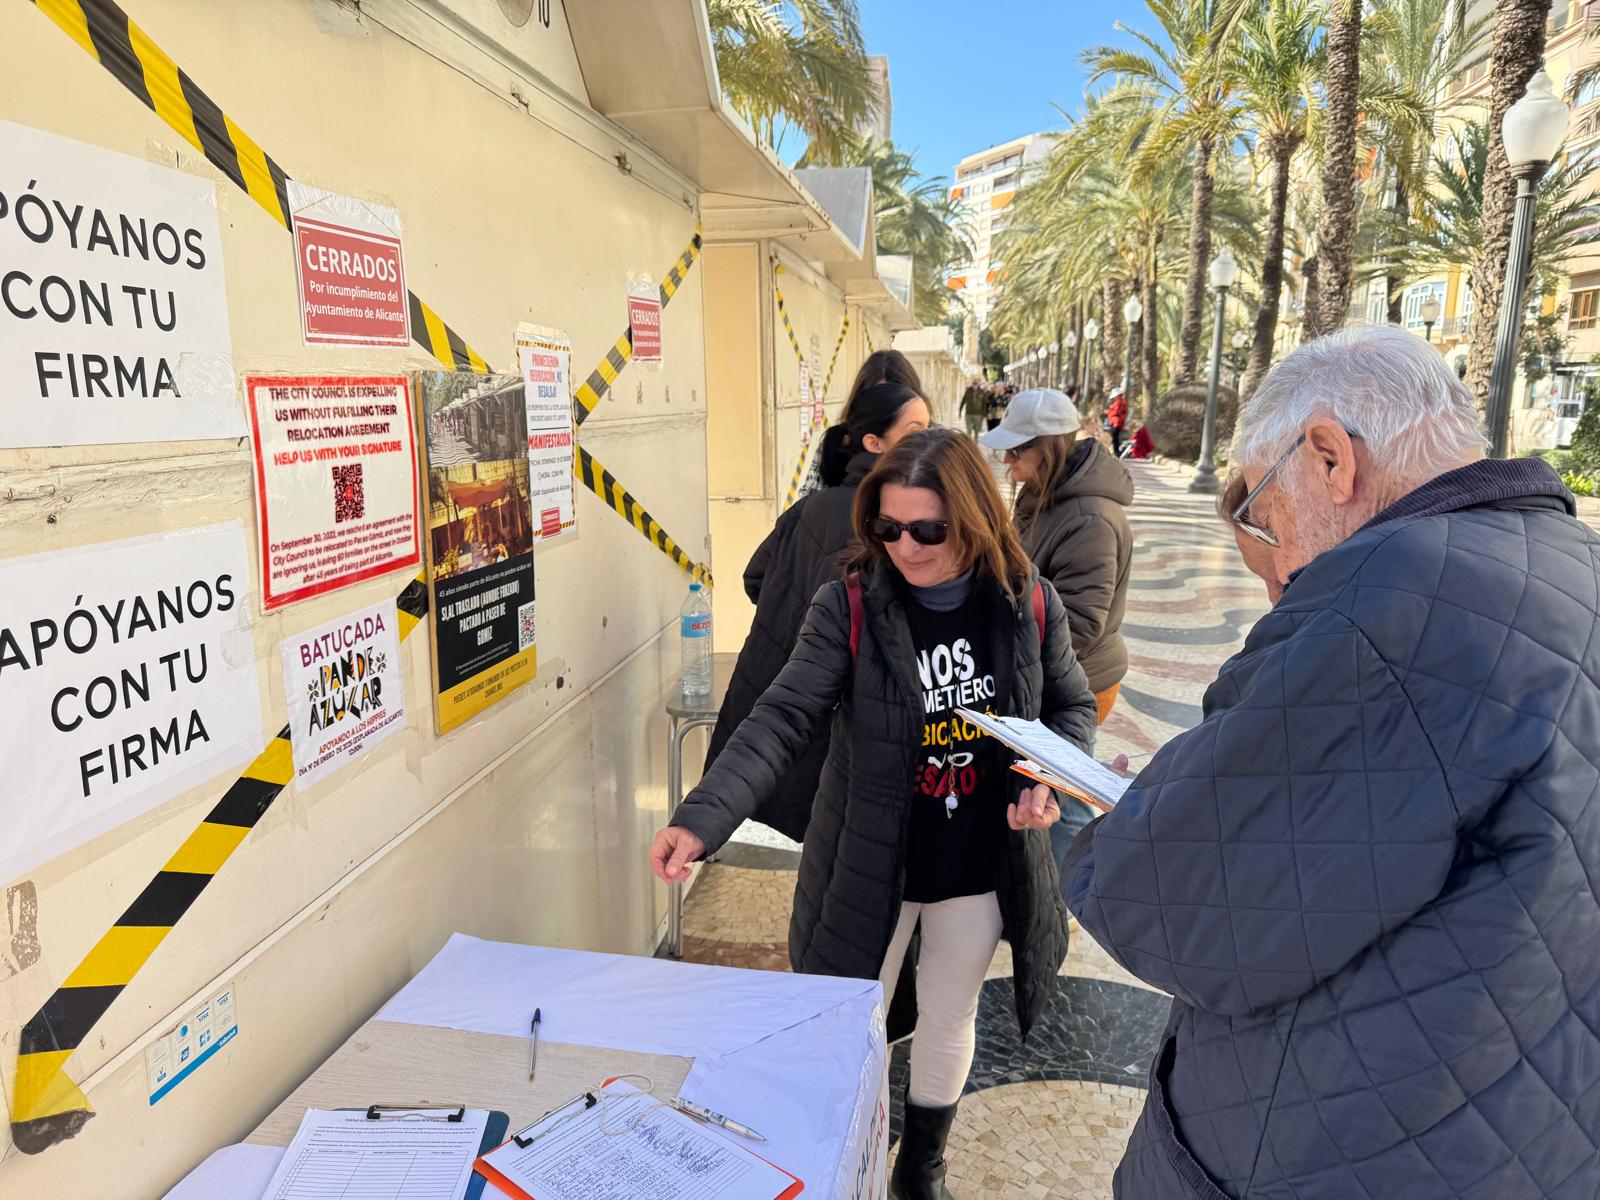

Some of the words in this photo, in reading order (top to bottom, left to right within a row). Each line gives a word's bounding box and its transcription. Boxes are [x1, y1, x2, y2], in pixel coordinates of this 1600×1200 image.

[306, 244, 397, 283] CERRADOS
[1, 271, 113, 326] CON
[122, 285, 176, 331] TU
[310, 281, 324, 293] Por
[326, 282, 386, 301] incumplimiento
[387, 291, 398, 302] del
[306, 301, 363, 318] Ayuntamiento
[364, 307, 374, 318] de
[375, 308, 404, 322] Alicante
[34, 352, 181, 398] FIRMA
[268, 388, 289, 400] THE
[291, 388, 310, 398] CITY
[311, 387, 346, 397] COUNCIL
[348, 387, 355, 397] IS
[356, 387, 397, 397] EXPELLING
[275, 410, 288, 420] US
[289, 408, 331, 420] WITHOUT
[332, 406, 374, 417] FULFILLING
[375, 405, 397, 415] THEIR
[286, 426, 343, 441] RELOCATION
[344, 423, 390, 435] AGREEMENT
[528, 430, 571, 450] MANIFESTACIÓN
[273, 451, 298, 465] HELP
[299, 450, 312, 462] US
[313, 447, 336, 459] WITH
[338, 445, 359, 457] YOUR
[361, 441, 402, 454] SIGNATURE
[270, 543, 280, 552] On
[281, 536, 312, 550] September
[346, 524, 364, 534] reached
[372, 518, 396, 529] agreement
[272, 555, 285, 566] City
[286, 550, 307, 562] Council
[323, 541, 347, 552] relocated
[353, 535, 368, 544] Paseo
[283, 563, 308, 577] ignoring
[317, 555, 336, 568] leaving
[344, 547, 363, 557] families
[378, 540, 391, 548] street
[396, 535, 412, 543] October
[303, 573, 315, 583] after
[323, 568, 338, 578] years
[344, 561, 358, 571] being
[359, 559, 369, 567] part
[456, 583, 468, 592] siendo
[469, 580, 479, 588] parte
[485, 572, 499, 582] Alicante
[455, 594, 479, 615] TRASLADO
[459, 612, 481, 633] PACTADO
[481, 610, 485, 623] A
[486, 605, 499, 621] PASEO
[499, 602, 505, 615] DE
[0, 574, 235, 676] APÓYANOS
[300, 614, 385, 667] BATUCADA
[51, 663, 150, 732] CON
[159, 643, 208, 692] TU
[320, 650, 355, 697] PAN
[356, 647, 375, 682] DE
[318, 730, 349, 754] APOYANDO
[350, 727, 355, 736] A
[355, 720, 366, 733] LOS
[79, 709, 210, 797] FIRMA
